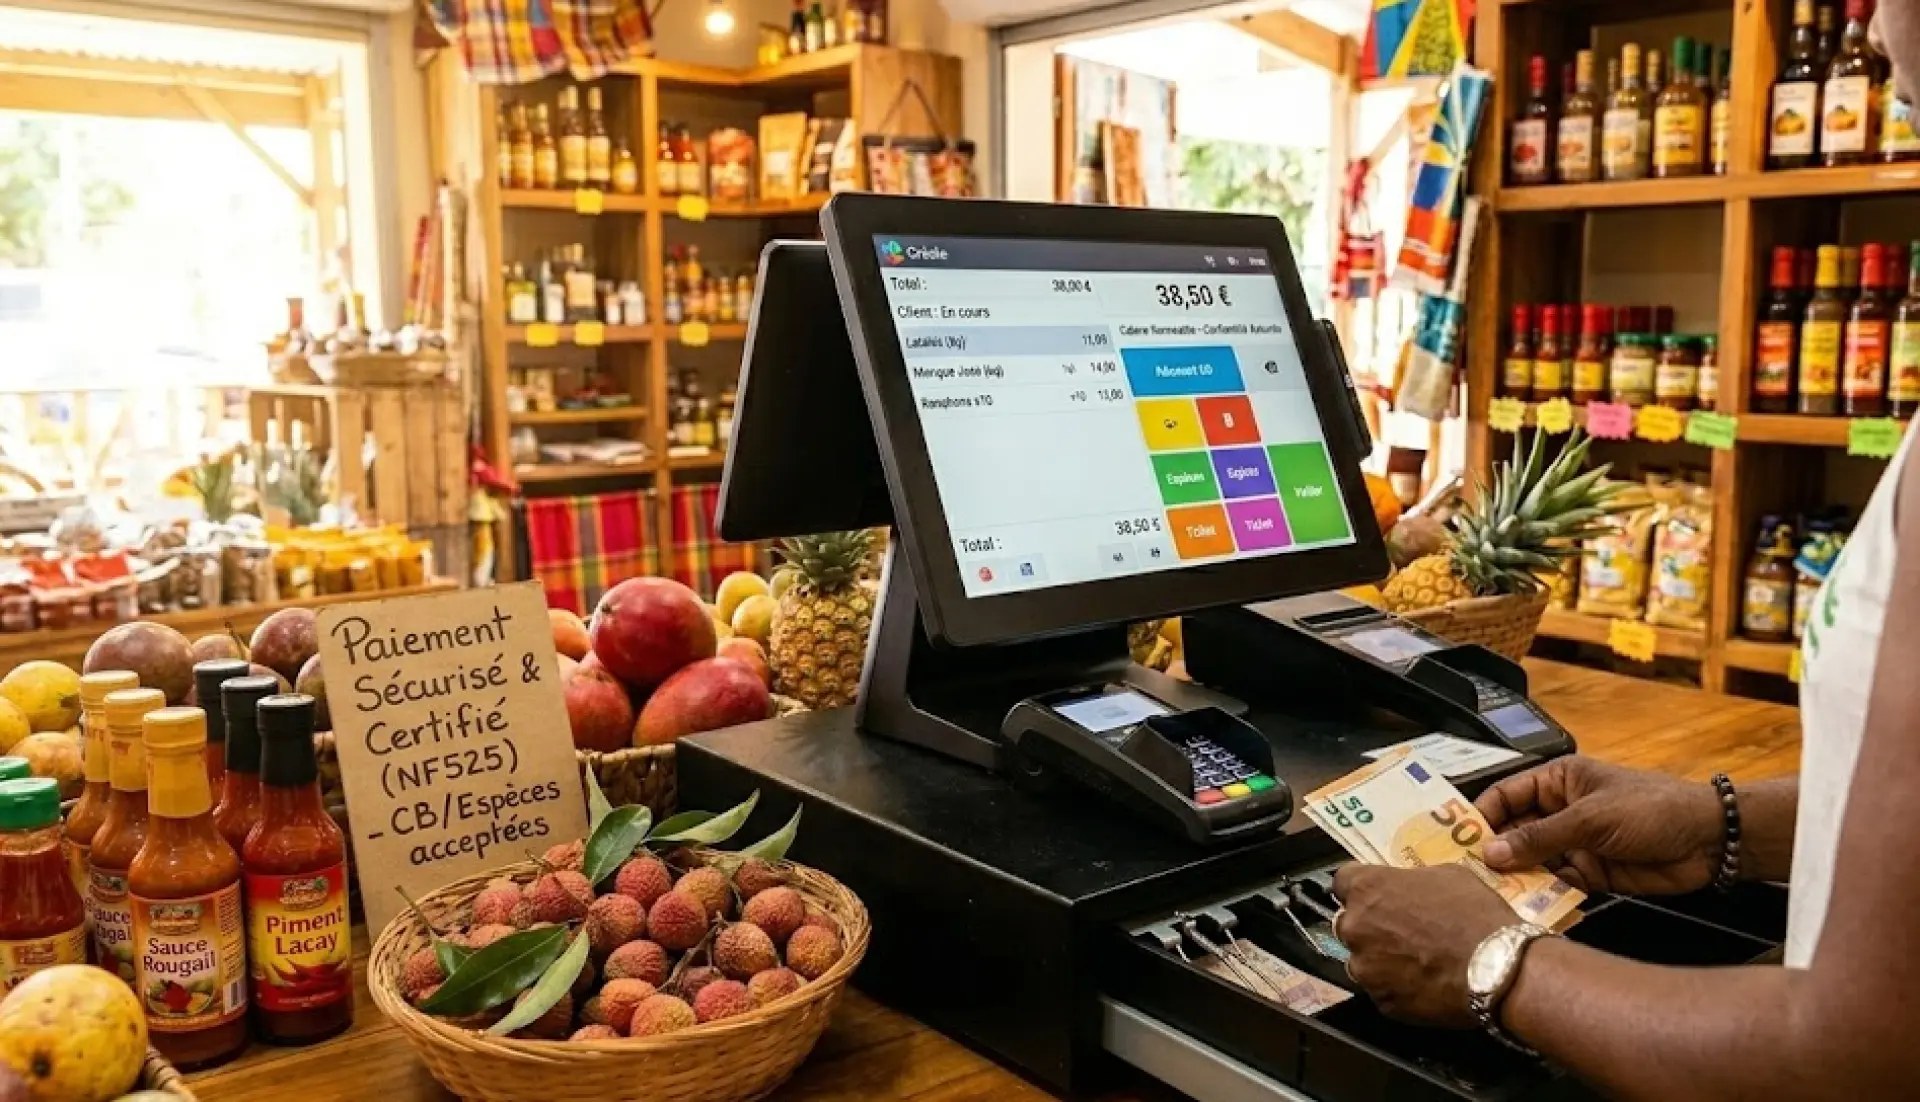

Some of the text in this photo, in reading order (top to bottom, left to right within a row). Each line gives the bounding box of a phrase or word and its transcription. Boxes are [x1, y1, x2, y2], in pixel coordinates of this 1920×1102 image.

[940, 306, 955, 319] En
[959, 308, 990, 321] cours
[1156, 284, 1233, 310] 38,50 €
[330, 605, 512, 665] Paiement
[354, 651, 541, 712] Sécurisé &
[365, 696, 508, 755] Certifié
[382, 737, 518, 799] (NF525)
[391, 780, 561, 836] CB/Espèces
[1342, 796, 1374, 823] 50
[1430, 797, 1484, 847] 50
[409, 813, 550, 866] acceptées
[266, 906, 344, 935] Piment
[148, 937, 208, 955] Sauce
[275, 932, 338, 954] Lacay
[143, 951, 216, 977] Rougail
